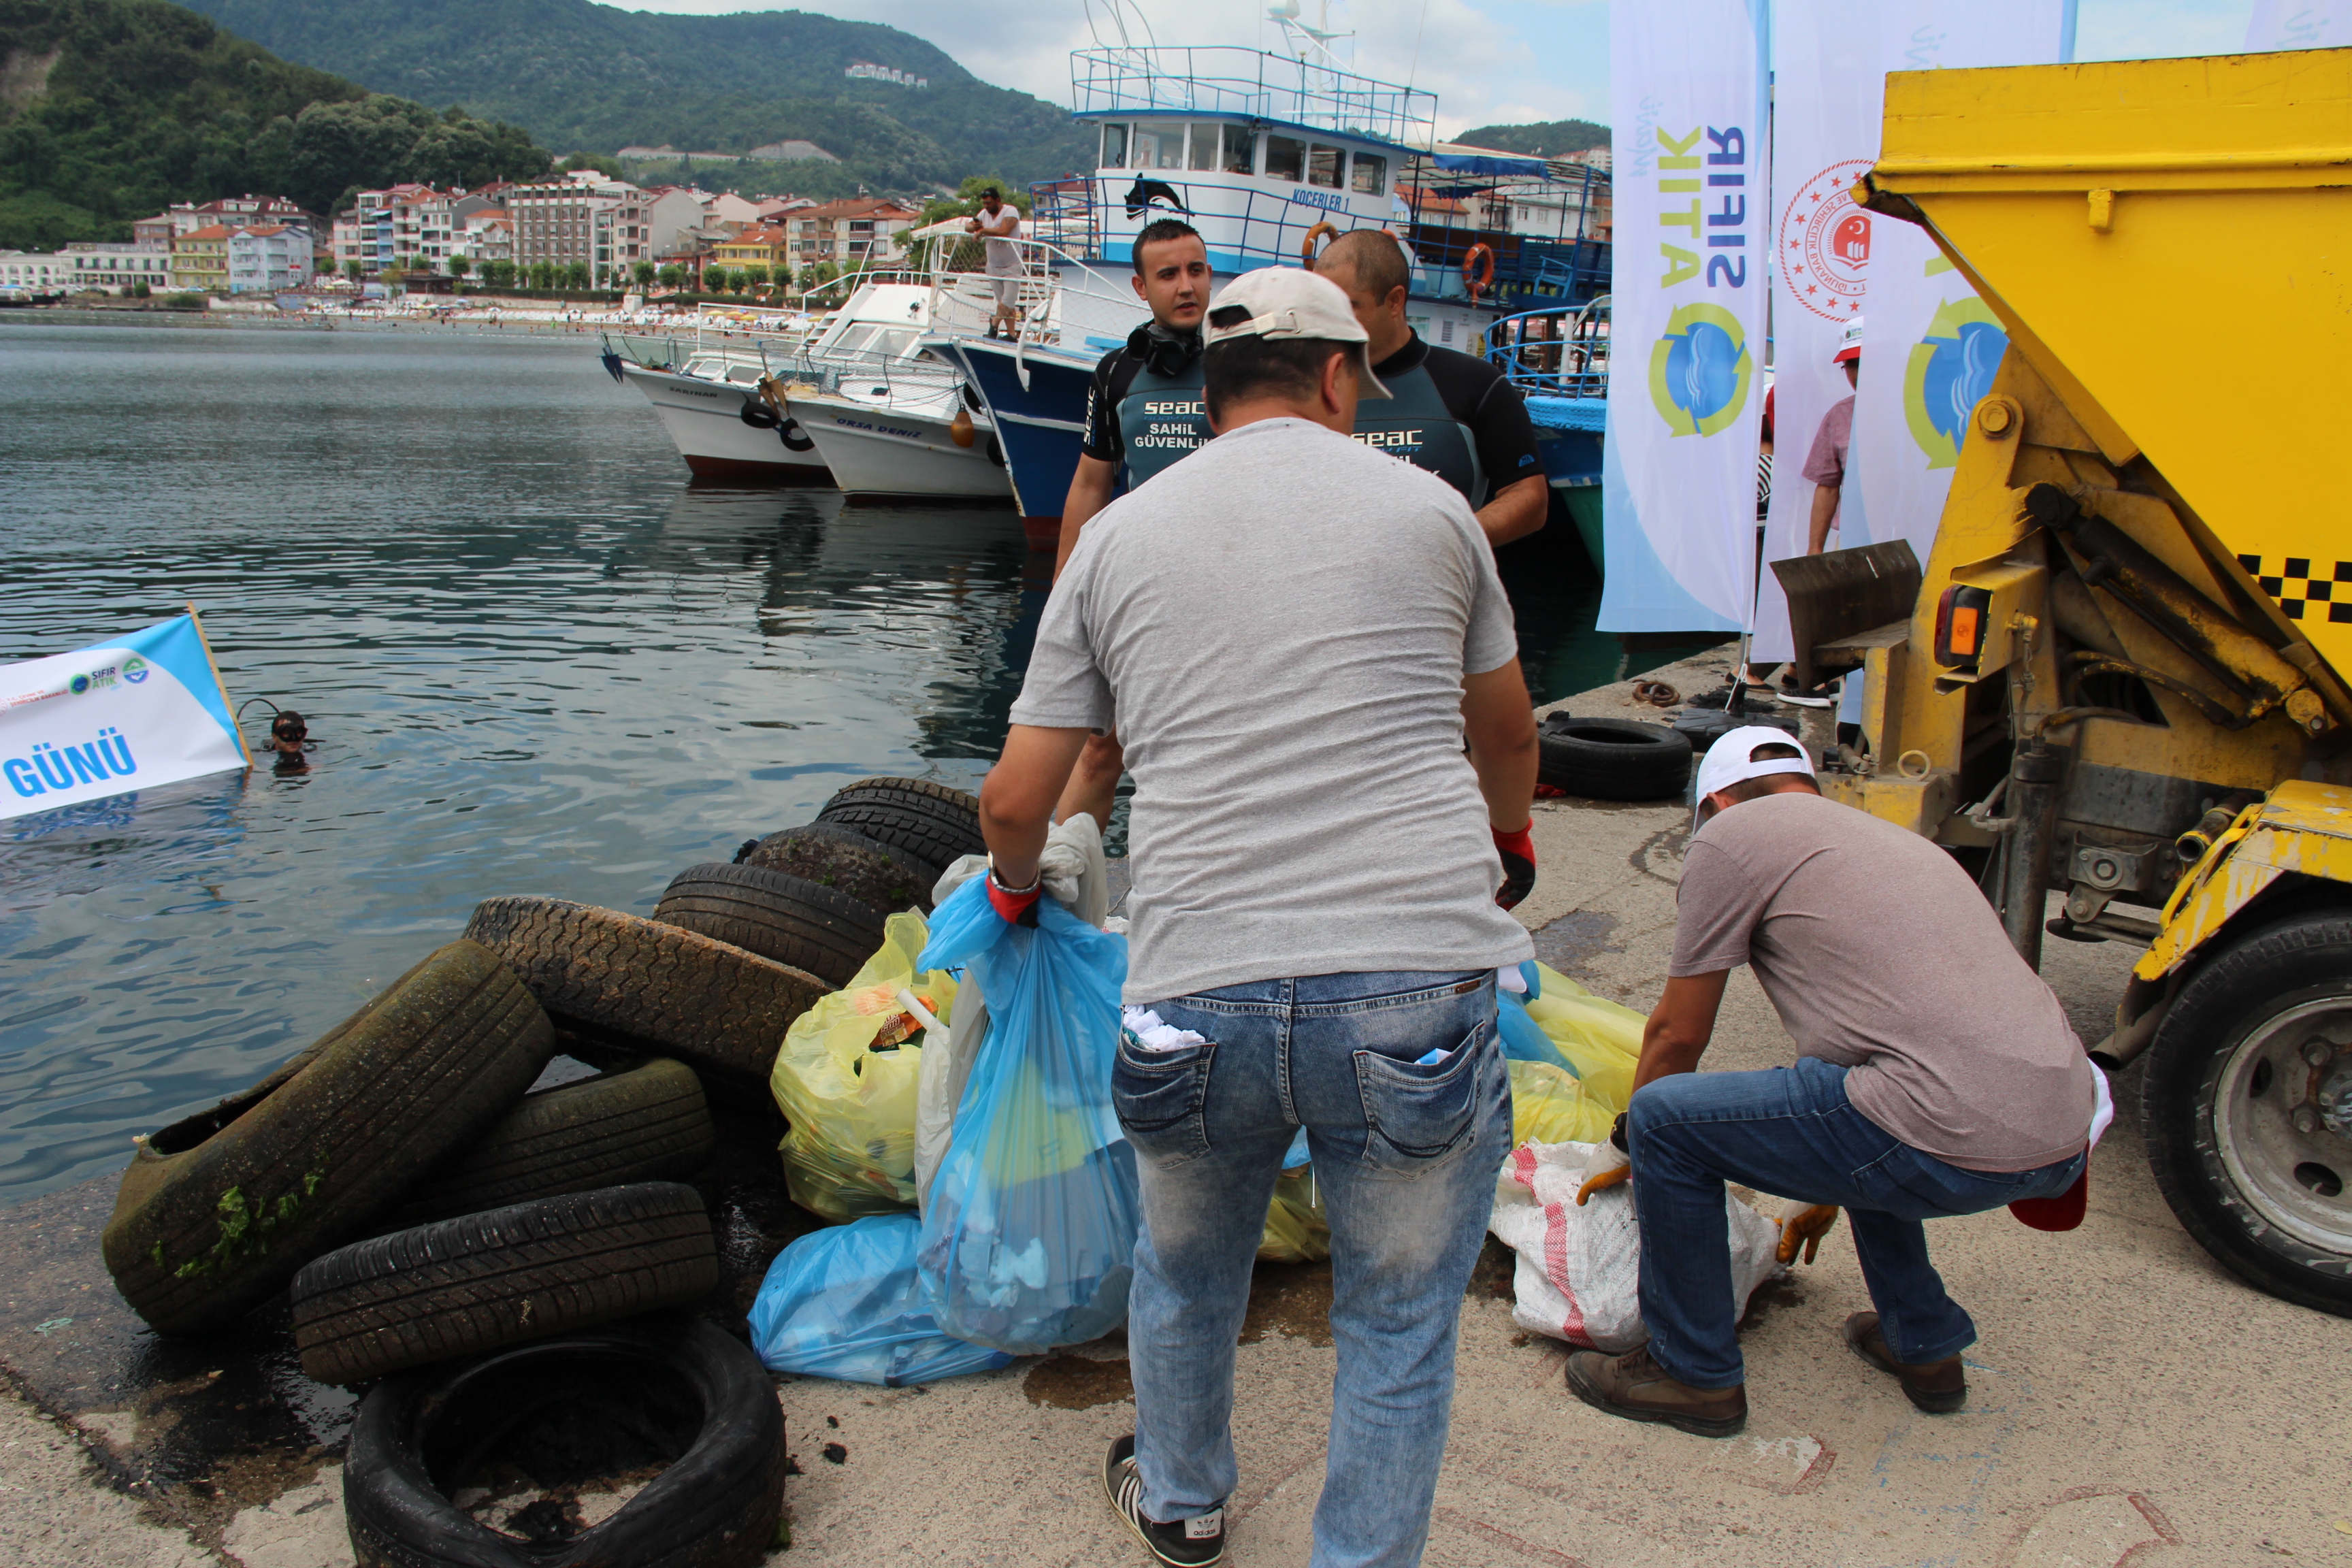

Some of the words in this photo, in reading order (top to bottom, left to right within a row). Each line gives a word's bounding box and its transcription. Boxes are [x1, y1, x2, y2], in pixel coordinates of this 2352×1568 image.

[1292, 189, 1342, 212] KOÇERLER
[1345, 197, 1350, 212] 1
[1083, 386, 1095, 445] seac
[1144, 402, 1205, 415] seac
[836, 418, 872, 430] ORSA
[91, 666, 116, 681] SIFIR
[91, 675, 117, 689] ATIK
[3, 726, 137, 798] GÜNÜ
